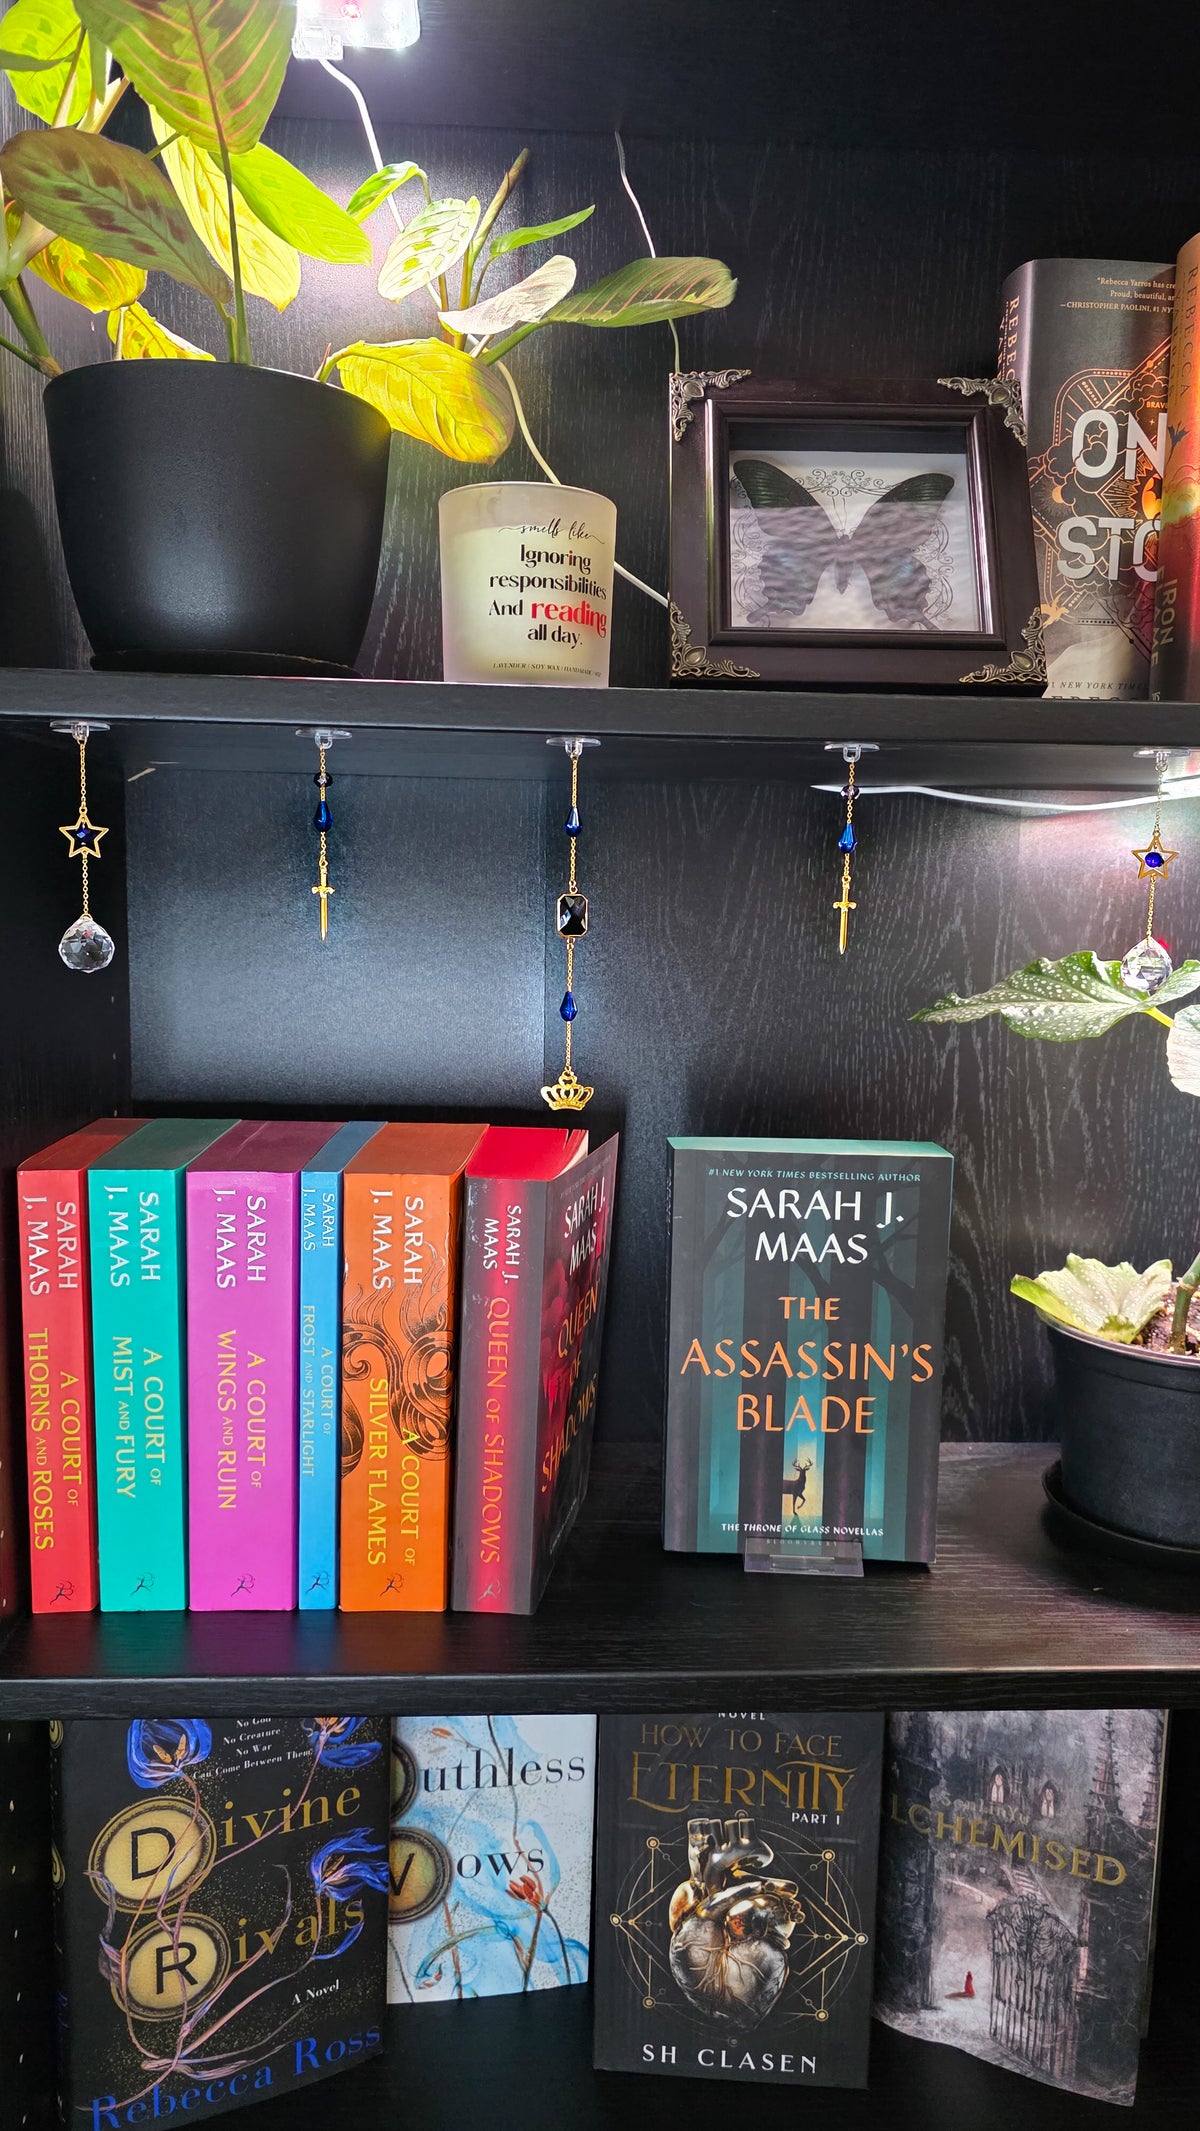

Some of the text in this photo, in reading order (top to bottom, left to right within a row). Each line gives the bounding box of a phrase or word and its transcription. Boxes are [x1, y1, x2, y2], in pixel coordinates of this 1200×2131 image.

[1110, 290, 1132, 298] Proud,
[1134, 291, 1166, 301] beautiful,
[1120, 304, 1151, 313] PAOLINI,
[1130, 278, 1152, 287] Yarros
[1153, 280, 1164, 288] has
[1180, 265, 1198, 398] REBECCA
[499, 517, 605, 544] smells like
[489, 574, 607, 600] responsibilities
[520, 543, 591, 575] Ignoring
[488, 599, 607, 639] And reading
[527, 624, 583, 650] all day.
[1161, 578, 1178, 645] IRON
[1060, 681, 1085, 689] NEW
[1087, 681, 1114, 690] YORK
[708, 1168, 921, 1182] #1 NEW YORK TIMES BESTSELLING AUTHOR
[302, 1187, 316, 1250] J. MAAS
[322, 1192, 334, 1247] SARAH
[564, 1176, 606, 1239] SARAH J.
[726, 1187, 904, 1229] SARAH J.
[22, 1195, 50, 1296] J. MAAS
[56, 1201, 78, 1290] SARAH
[104, 1185, 130, 1288] J. MAAS
[139, 1192, 161, 1282] SARAH
[213, 1188, 236, 1289] J. MAAS
[247, 1195, 267, 1283] SARAH
[370, 1188, 393, 1290] J. MAAS
[403, 1198, 423, 1285] SARAH
[482, 1217, 499, 1270] MAAS
[502, 1204, 521, 1284] SARAH J.
[569, 1221, 597, 1277] MAAS
[754, 1231, 869, 1265] MAAS
[302, 1305, 316, 1356] FROST
[558, 1280, 600, 1359] QUEEN
[778, 1296, 840, 1321] THE
[320, 1347, 333, 1435] A COURT OF
[569, 1350, 582, 1386] OF
[27, 1328, 54, 1550] THORNS AND ROSES
[60, 1371, 82, 1507] A COURT OF
[112, 1336, 136, 1500] MIST AND FURY
[143, 1347, 166, 1487] A COURT OF
[216, 1330, 237, 1509] WINGS AND RUIN
[247, 1351, 266, 1489] A COURT OF
[302, 1387, 315, 1477] STARLIGHT
[480, 1296, 510, 1564] QUEEN OF SHADOWS
[541, 1372, 598, 1493] SHADOWS
[736, 1394, 877, 1434] BLADE
[367, 1376, 388, 1566] SILVER FLAMES
[399, 1427, 421, 1566] A COURT OF
[721, 1523, 884, 1537] THE THRONE OF GLASS NOVELLAS
[223, 1728, 280, 1745] No Creature
[236, 1743, 272, 1757] No War
[237, 1719, 249, 1728] No
[641, 1723, 842, 1758] HOW TO FACE
[193, 1770, 212, 1780] Can
[215, 1764, 241, 1776] Come
[244, 1755, 282, 1769] Between
[421, 1746, 585, 1794] uthless
[627, 1751, 858, 1813] ETERNITY
[791, 1812, 828, 1824] PART
[292, 1979, 340, 2006] A Novel
[89, 2024, 381, 2131] Rebecca Ross
[642, 2044, 817, 2074] SH CLASEN
